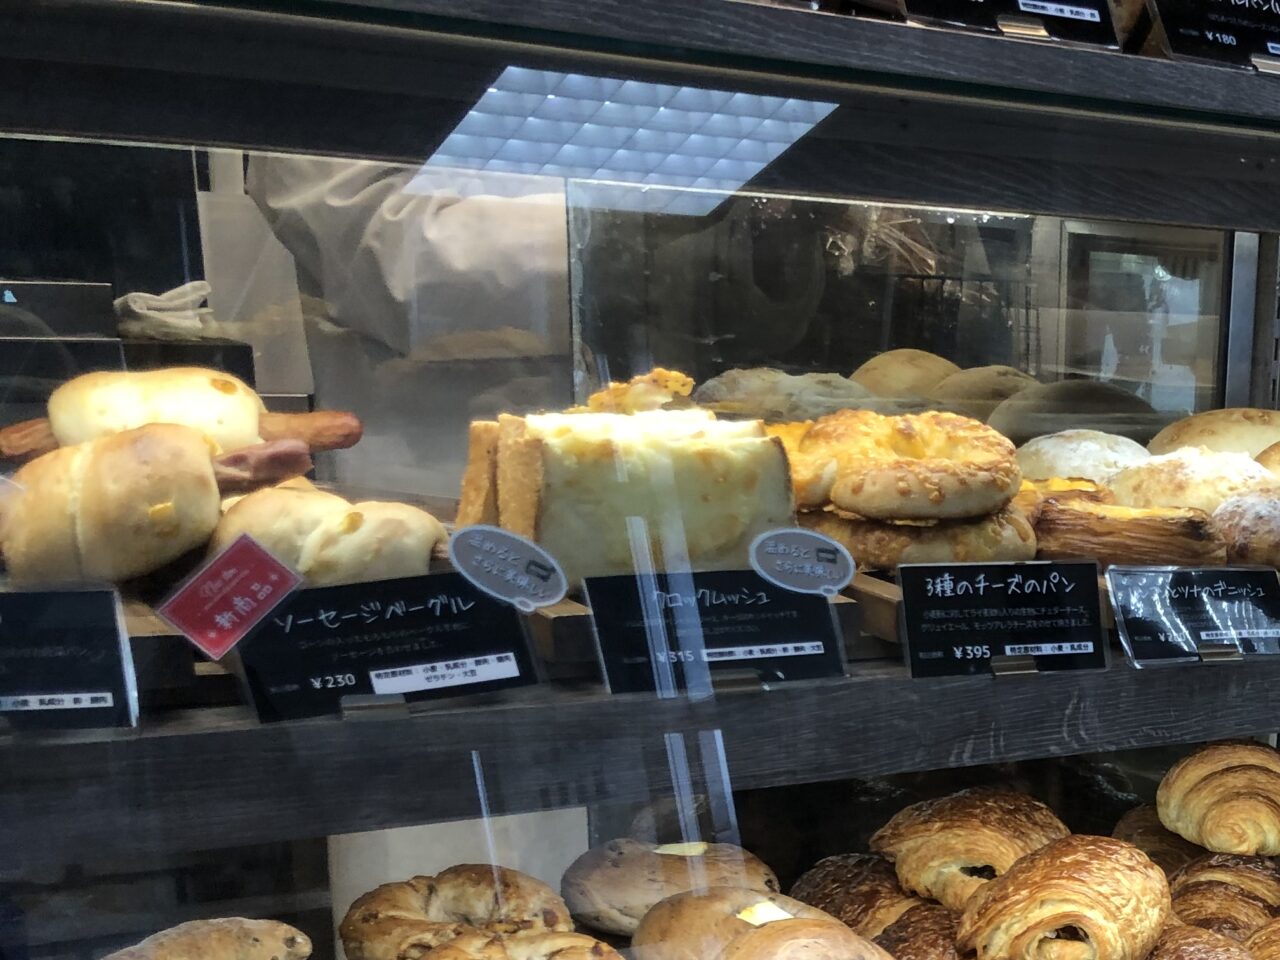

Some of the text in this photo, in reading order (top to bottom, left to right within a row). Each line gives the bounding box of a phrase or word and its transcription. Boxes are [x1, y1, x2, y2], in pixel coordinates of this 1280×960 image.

[925, 571, 1078, 598] 3種のチーズのパン
[273, 594, 477, 635] ソーセージベーグル
[953, 644, 992, 660] ¥395
[310, 672, 357, 691] ¥230
